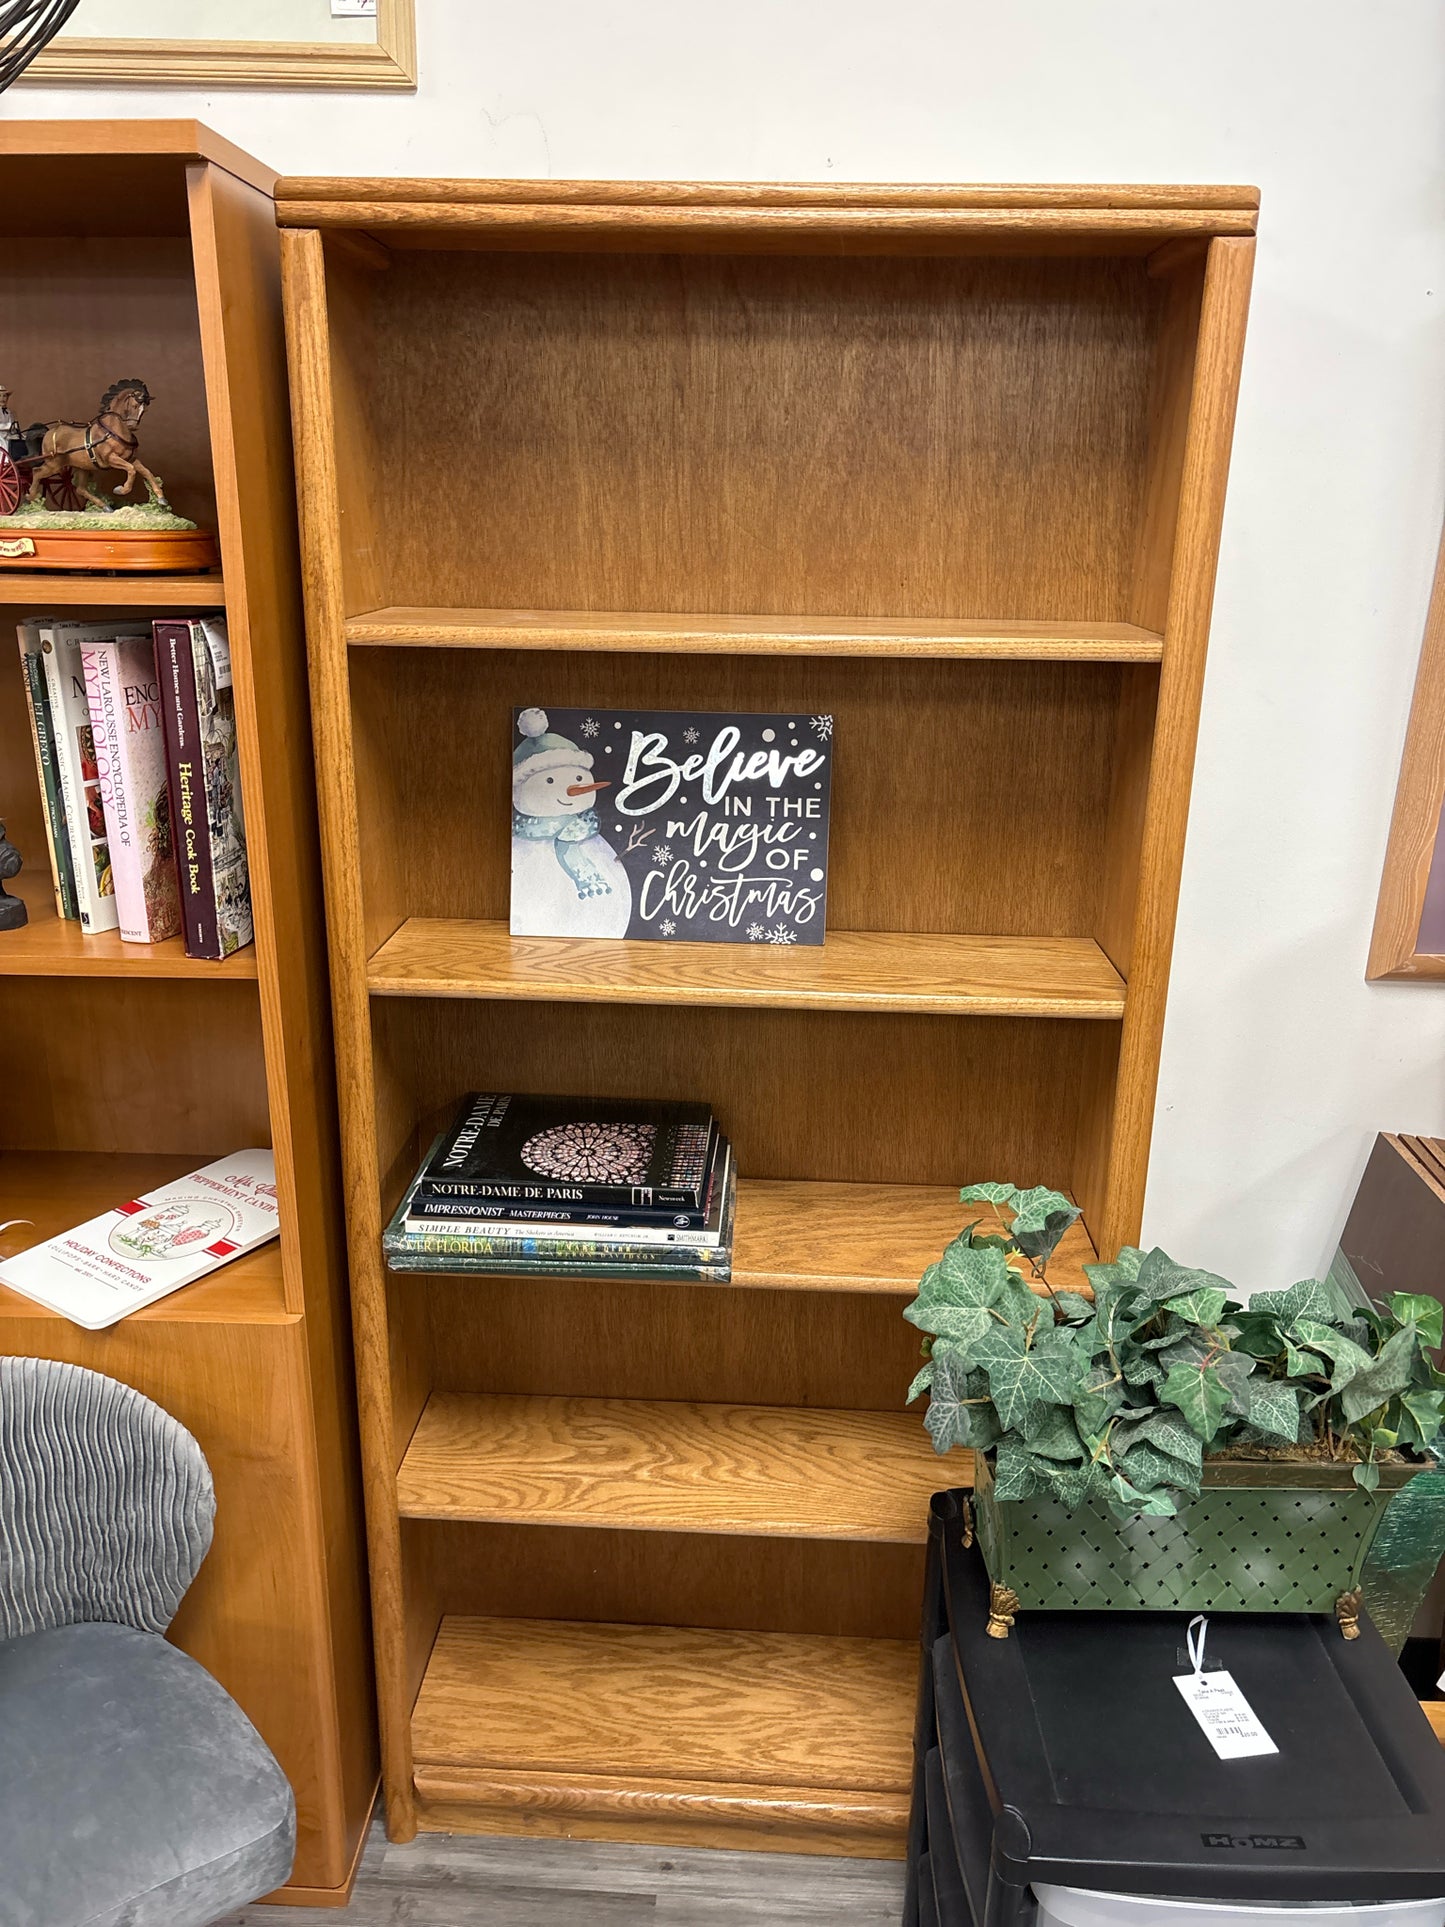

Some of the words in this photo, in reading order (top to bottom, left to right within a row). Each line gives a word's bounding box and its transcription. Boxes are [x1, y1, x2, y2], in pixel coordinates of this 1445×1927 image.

[98, 650, 110, 680] NEW
[34, 702, 43, 718] EL
[101, 682, 117, 742] LAROUSSE
[37, 721, 50, 766] GRECO
[81, 650, 115, 810] MYTHOLOGY
[109, 743, 128, 830] ENCYCLOPEDIA
[614, 726, 825, 816] Believe
[179, 762, 193, 825] Heritage
[724, 796, 752, 816] IN
[766, 797, 821, 818] THE
[61, 774, 71, 801] MAIN
[66, 804, 78, 849] COURSES
[120, 830, 130, 847] OF
[185, 829, 199, 861] Cook
[666, 811, 802, 872] magic
[766, 849, 809, 870] OF
[188, 864, 200, 894] Book
[640, 860, 824, 927] Christmas
[492, 1095, 513, 1116] PARIS
[443, 1094, 497, 1168] NOTRE-DAME
[486, 1116, 504, 1127] DE
[188, 1174, 247, 1200] PEPPERMINT
[244, 1197, 276, 1212] CANDY
[432, 1183, 522, 1197] NOTRE-DAME
[524, 1187, 544, 1198] DE
[546, 1189, 583, 1200] PARIS
[424, 1204, 504, 1216] IMPRESSIONIST
[509, 1210, 572, 1220] MASTERPIECES
[418, 1224, 461, 1233] SIMPLE
[465, 1226, 512, 1236] BEAUTY
[63, 1239, 98, 1256] HOLIDAY
[95, 1254, 152, 1284] CONFECTIONS
[399, 1240, 430, 1252] OVER
[436, 1240, 494, 1254] FLORIDA
[1208, 1836, 1298, 1848] HOMZ
